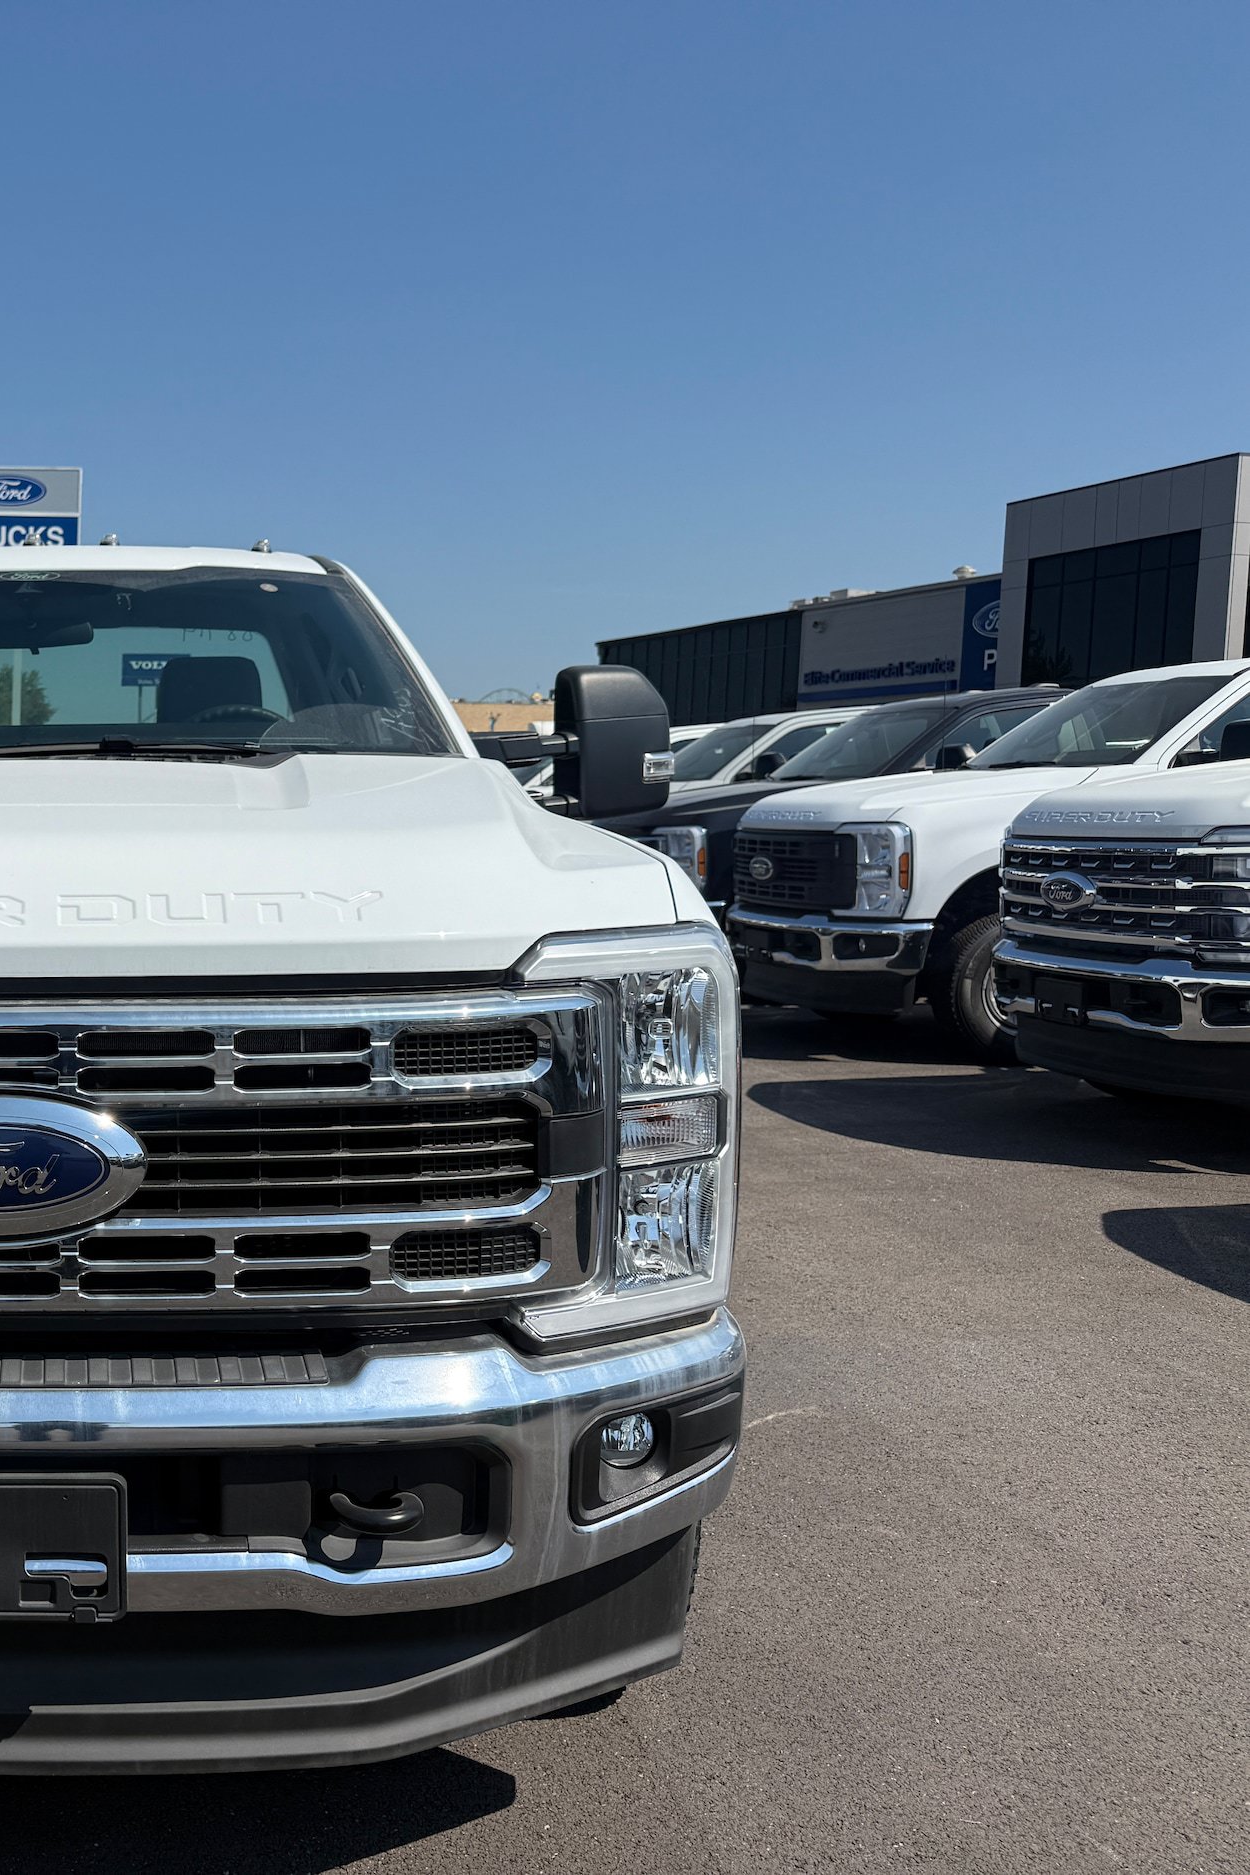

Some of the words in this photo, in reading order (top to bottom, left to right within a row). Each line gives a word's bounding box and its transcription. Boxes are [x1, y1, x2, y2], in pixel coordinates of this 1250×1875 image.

[129, 660, 168, 670] VOL
[830, 660, 904, 684] Commercial
[905, 657, 956, 677] Service
[1093, 810, 1176, 823] DUTY
[1049, 883, 1073, 901] Ford
[56, 890, 384, 927] DUTY
